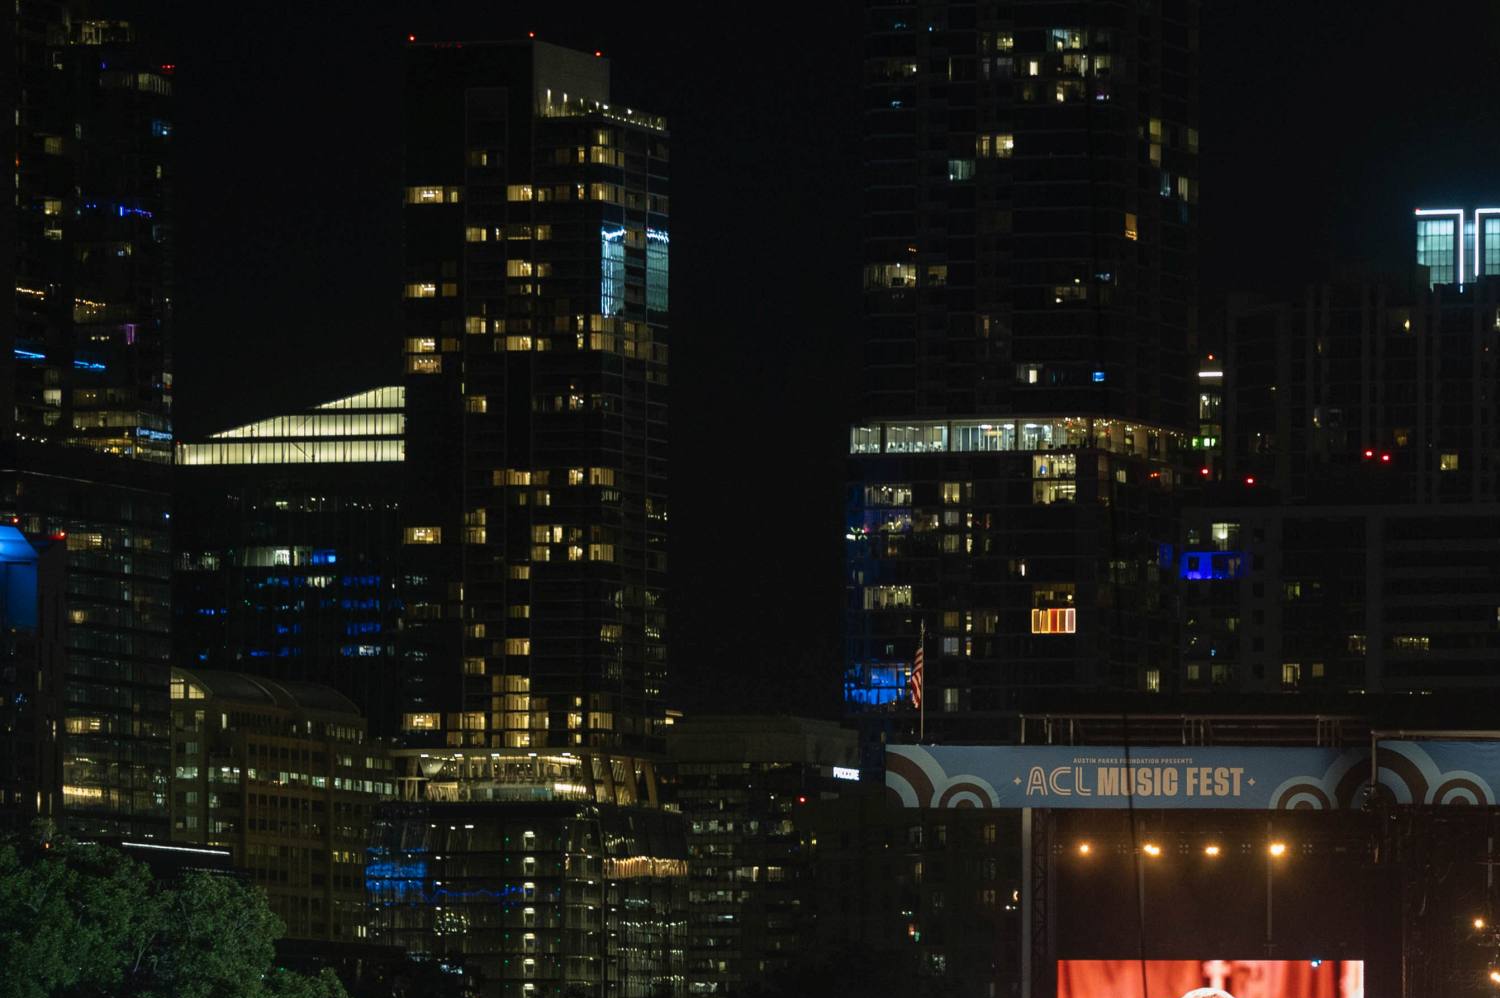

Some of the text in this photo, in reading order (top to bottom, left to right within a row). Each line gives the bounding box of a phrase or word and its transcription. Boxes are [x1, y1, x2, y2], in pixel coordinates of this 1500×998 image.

[1026, 766, 1244, 797] ACL MUSIC FEST
